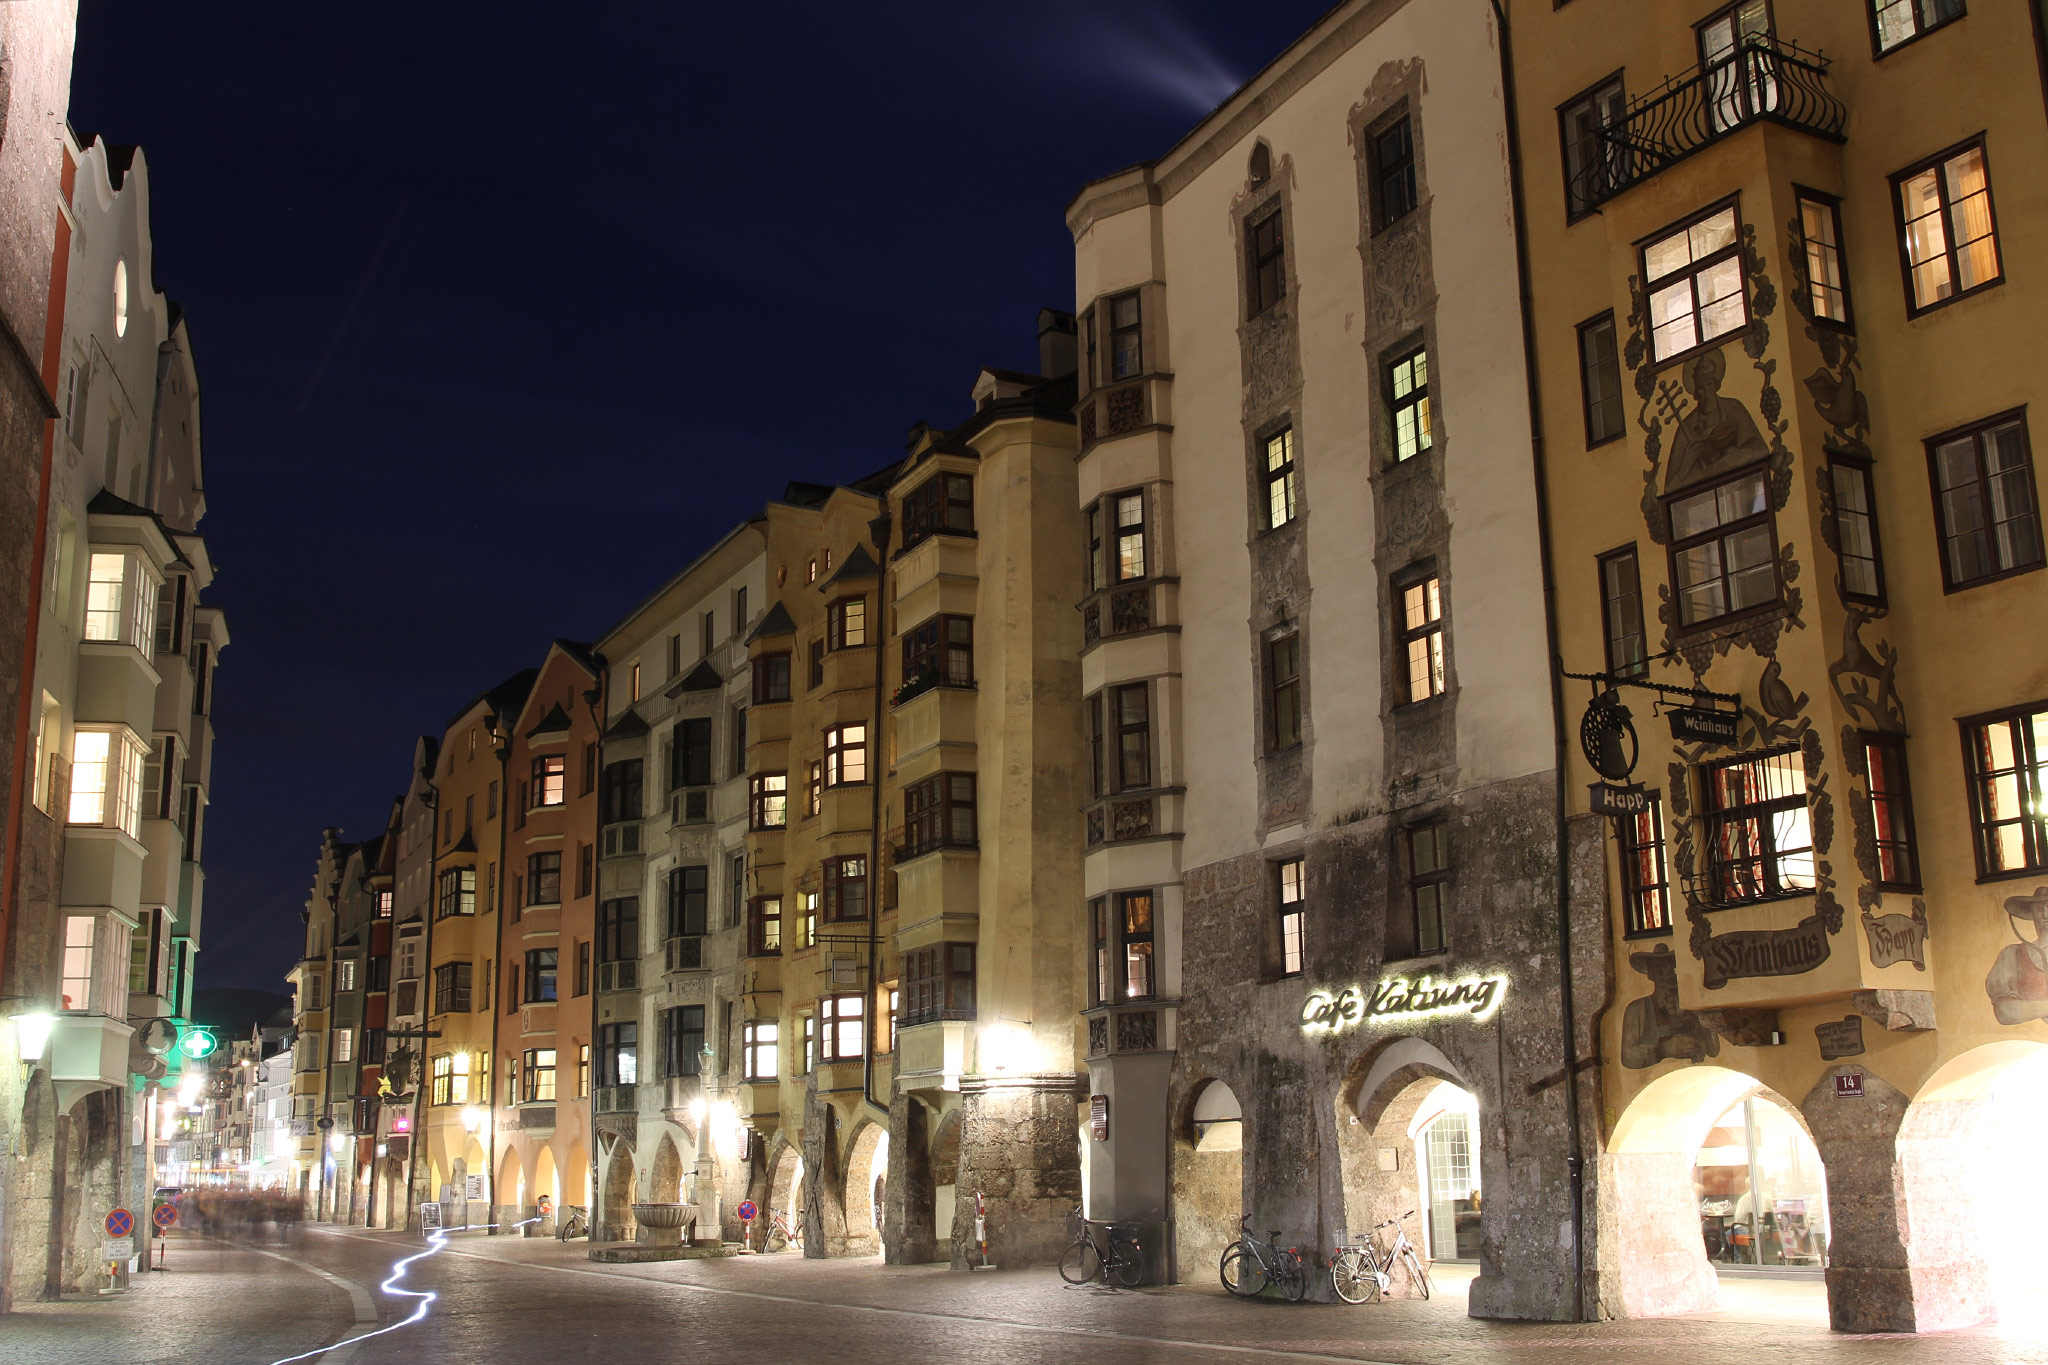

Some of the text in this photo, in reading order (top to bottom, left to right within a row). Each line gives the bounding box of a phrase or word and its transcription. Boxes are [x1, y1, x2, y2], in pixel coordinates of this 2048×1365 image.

[1683, 714, 1735, 737] Weinhaus
[1603, 788, 1644, 811] Happ
[1362, 979, 1499, 1018] Katzung
[1842, 1076, 1855, 1089] 14
